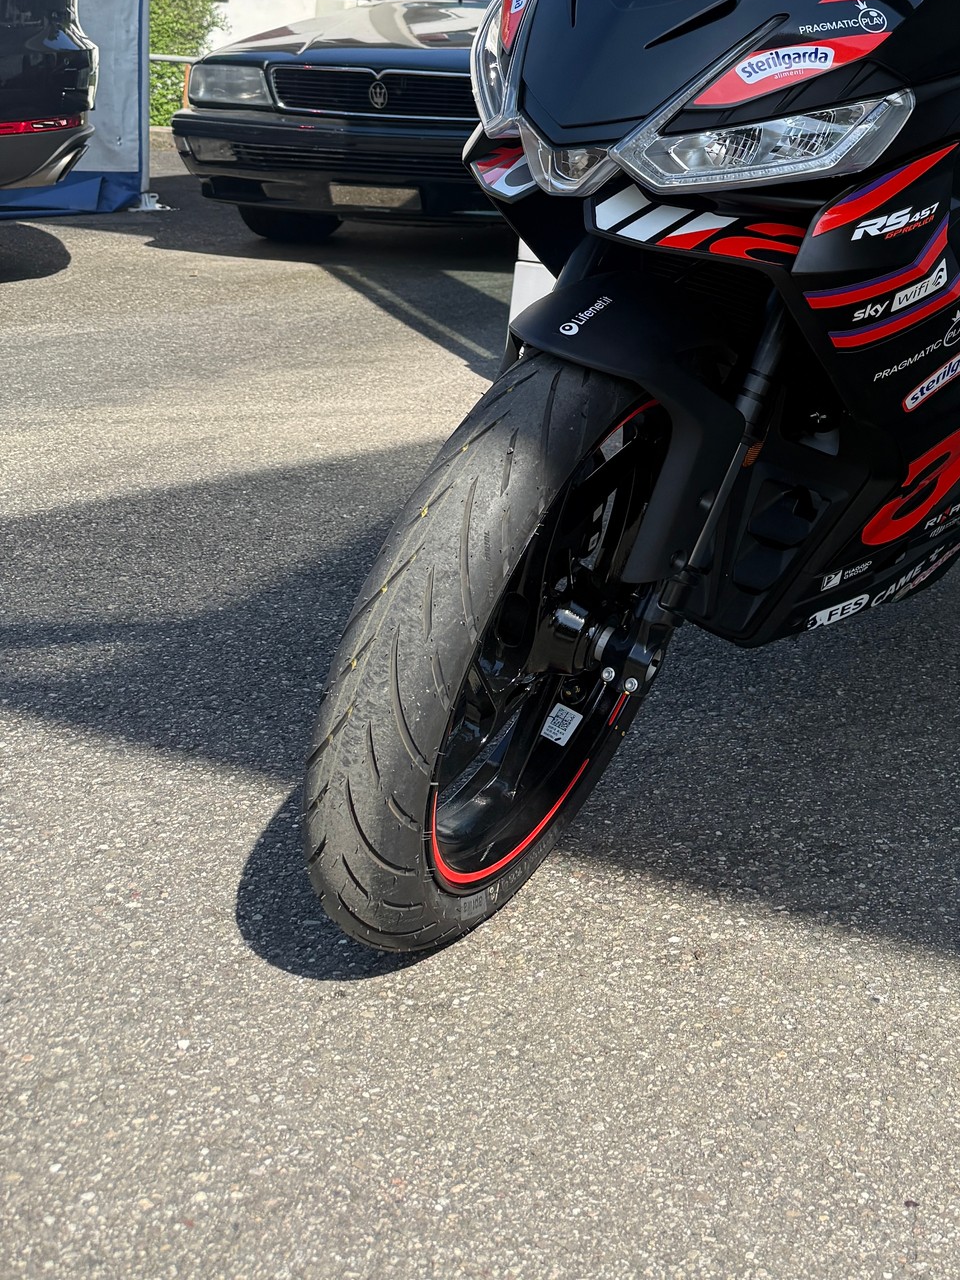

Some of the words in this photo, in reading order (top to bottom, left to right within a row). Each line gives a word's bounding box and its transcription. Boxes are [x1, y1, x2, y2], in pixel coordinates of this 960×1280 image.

[799, 19, 860, 35] PRAGMATIC
[861, 16, 885, 26] PLAY
[740, 47, 829, 79] sterilgarda
[773, 69, 804, 80] alimenti
[851, 206, 913, 241] RS
[909, 201, 940, 223] 457
[571, 296, 613, 325] Lifenet.it
[852, 300, 890, 322] sky
[898, 280, 930, 306] wifi
[873, 339, 943, 382] PRAGMATIC
[870, 561, 926, 608] CAME
